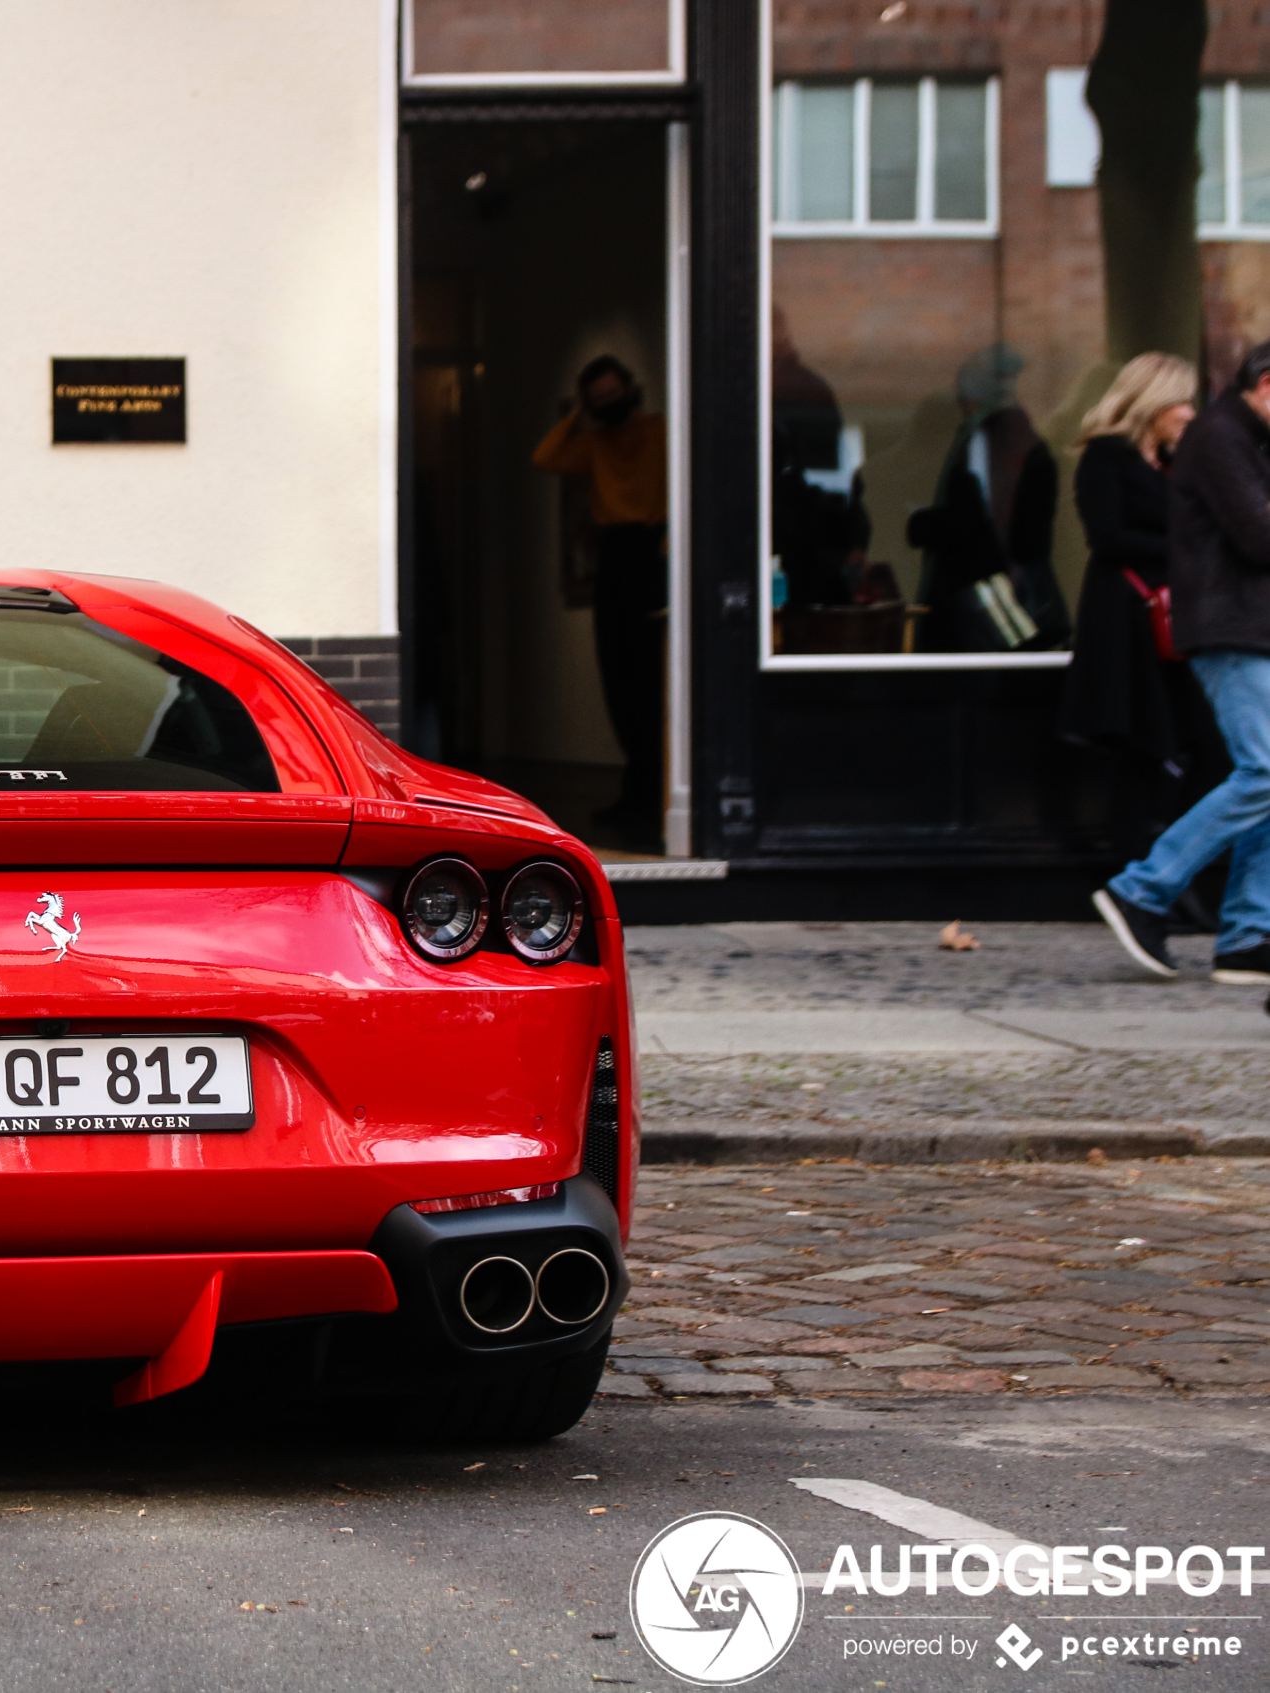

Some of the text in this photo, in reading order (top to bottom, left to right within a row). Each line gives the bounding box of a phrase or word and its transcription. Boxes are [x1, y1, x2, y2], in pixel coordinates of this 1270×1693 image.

[5, 1047, 83, 1106] QF
[106, 1046, 221, 1104] 812
[55, 1115, 191, 1130] SPORTWAGEN
